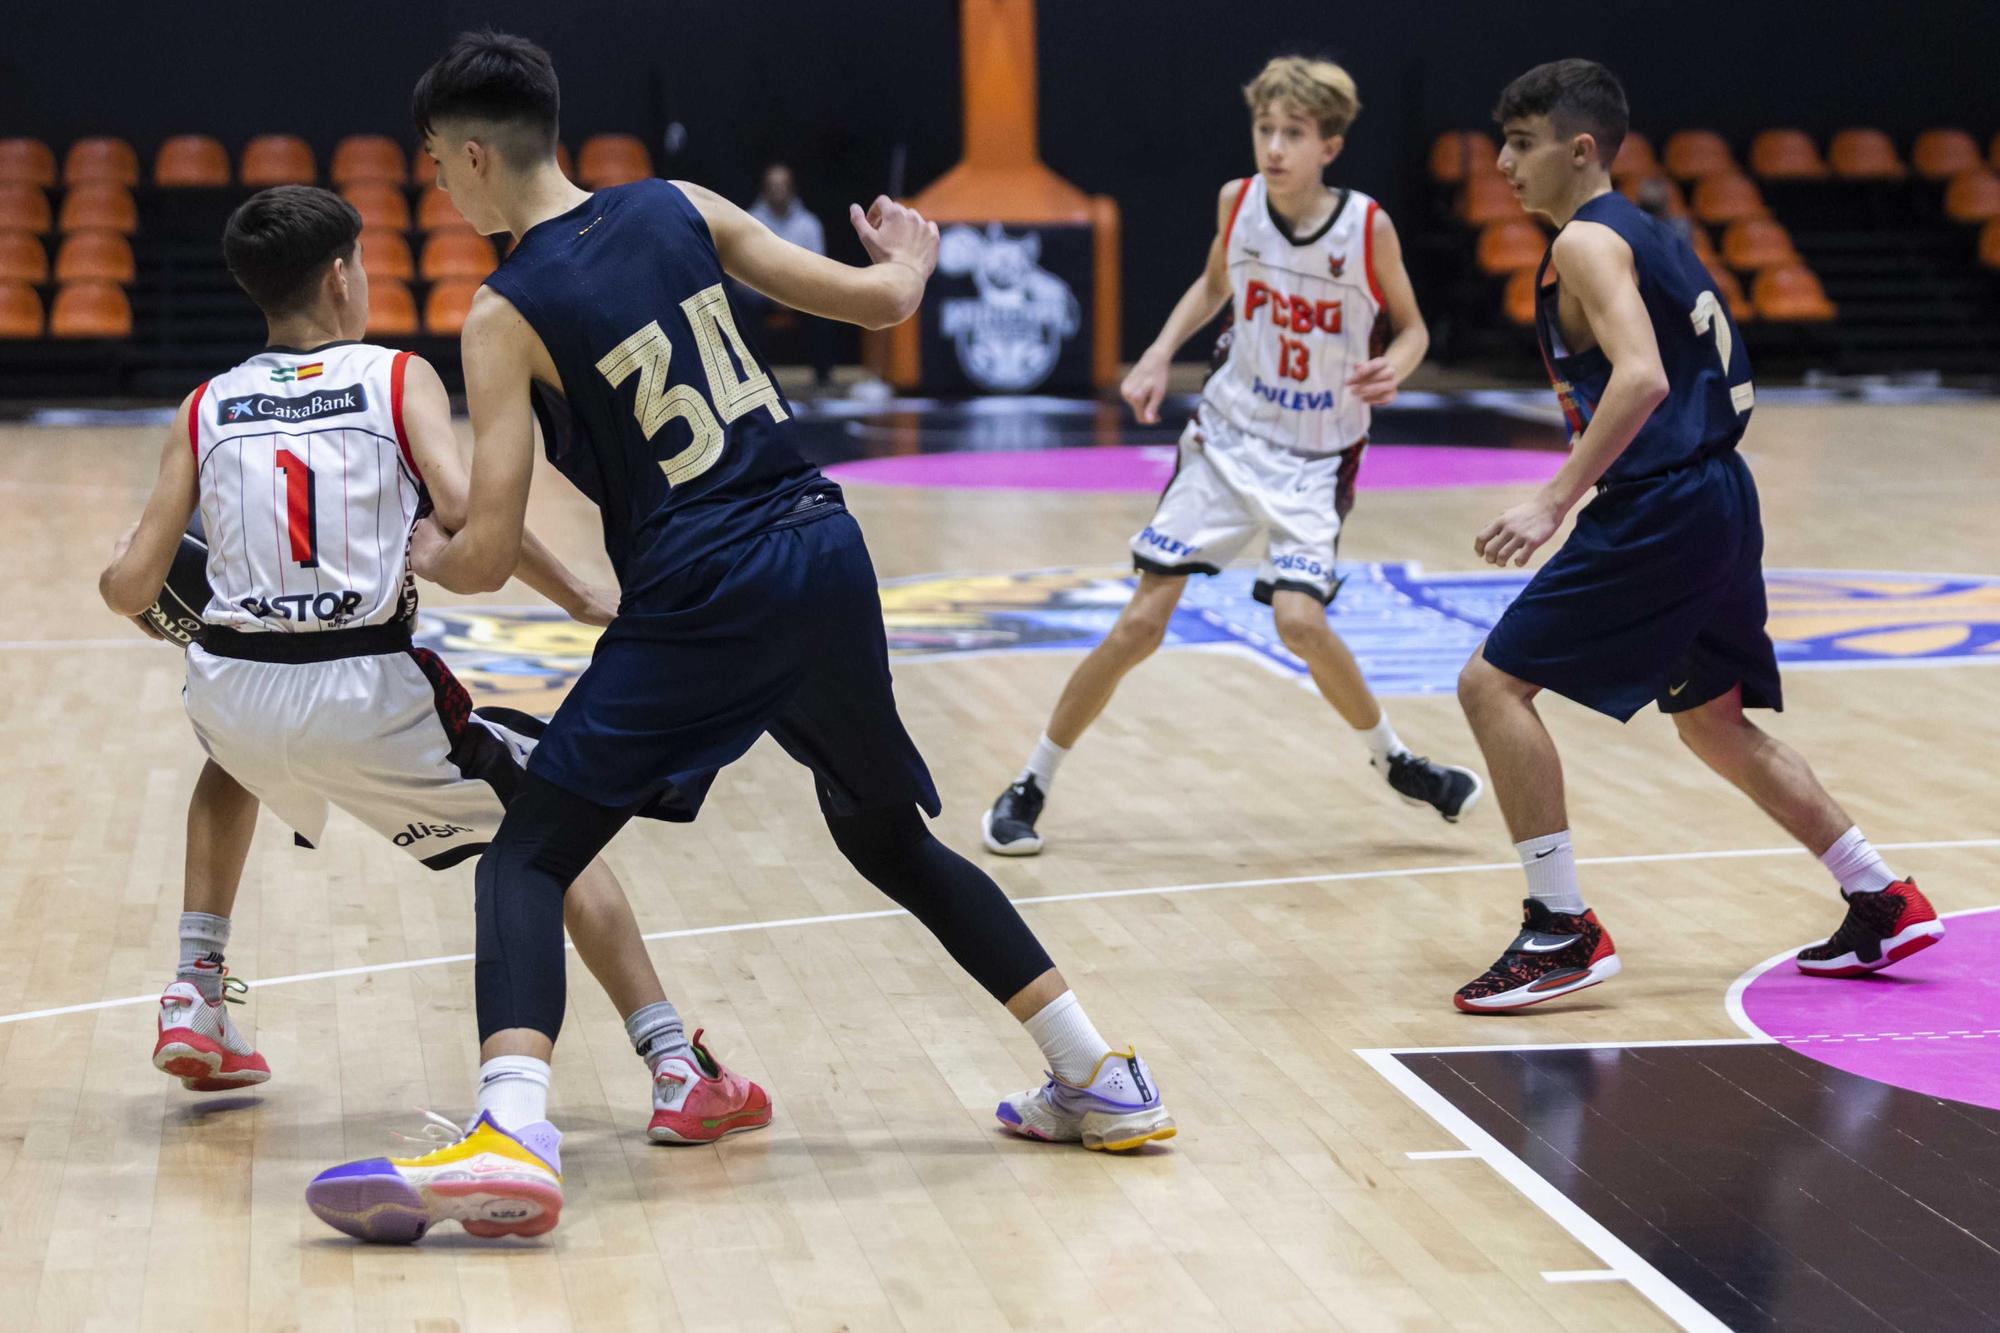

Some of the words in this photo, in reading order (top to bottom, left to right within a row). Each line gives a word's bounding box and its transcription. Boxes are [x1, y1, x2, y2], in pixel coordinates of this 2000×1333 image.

[1278, 334, 1309, 382] 13
[257, 392, 356, 419] CaixaBank
[595, 282, 789, 489] 34
[275, 449, 319, 568] 1
[1140, 526, 1199, 556] PULEV
